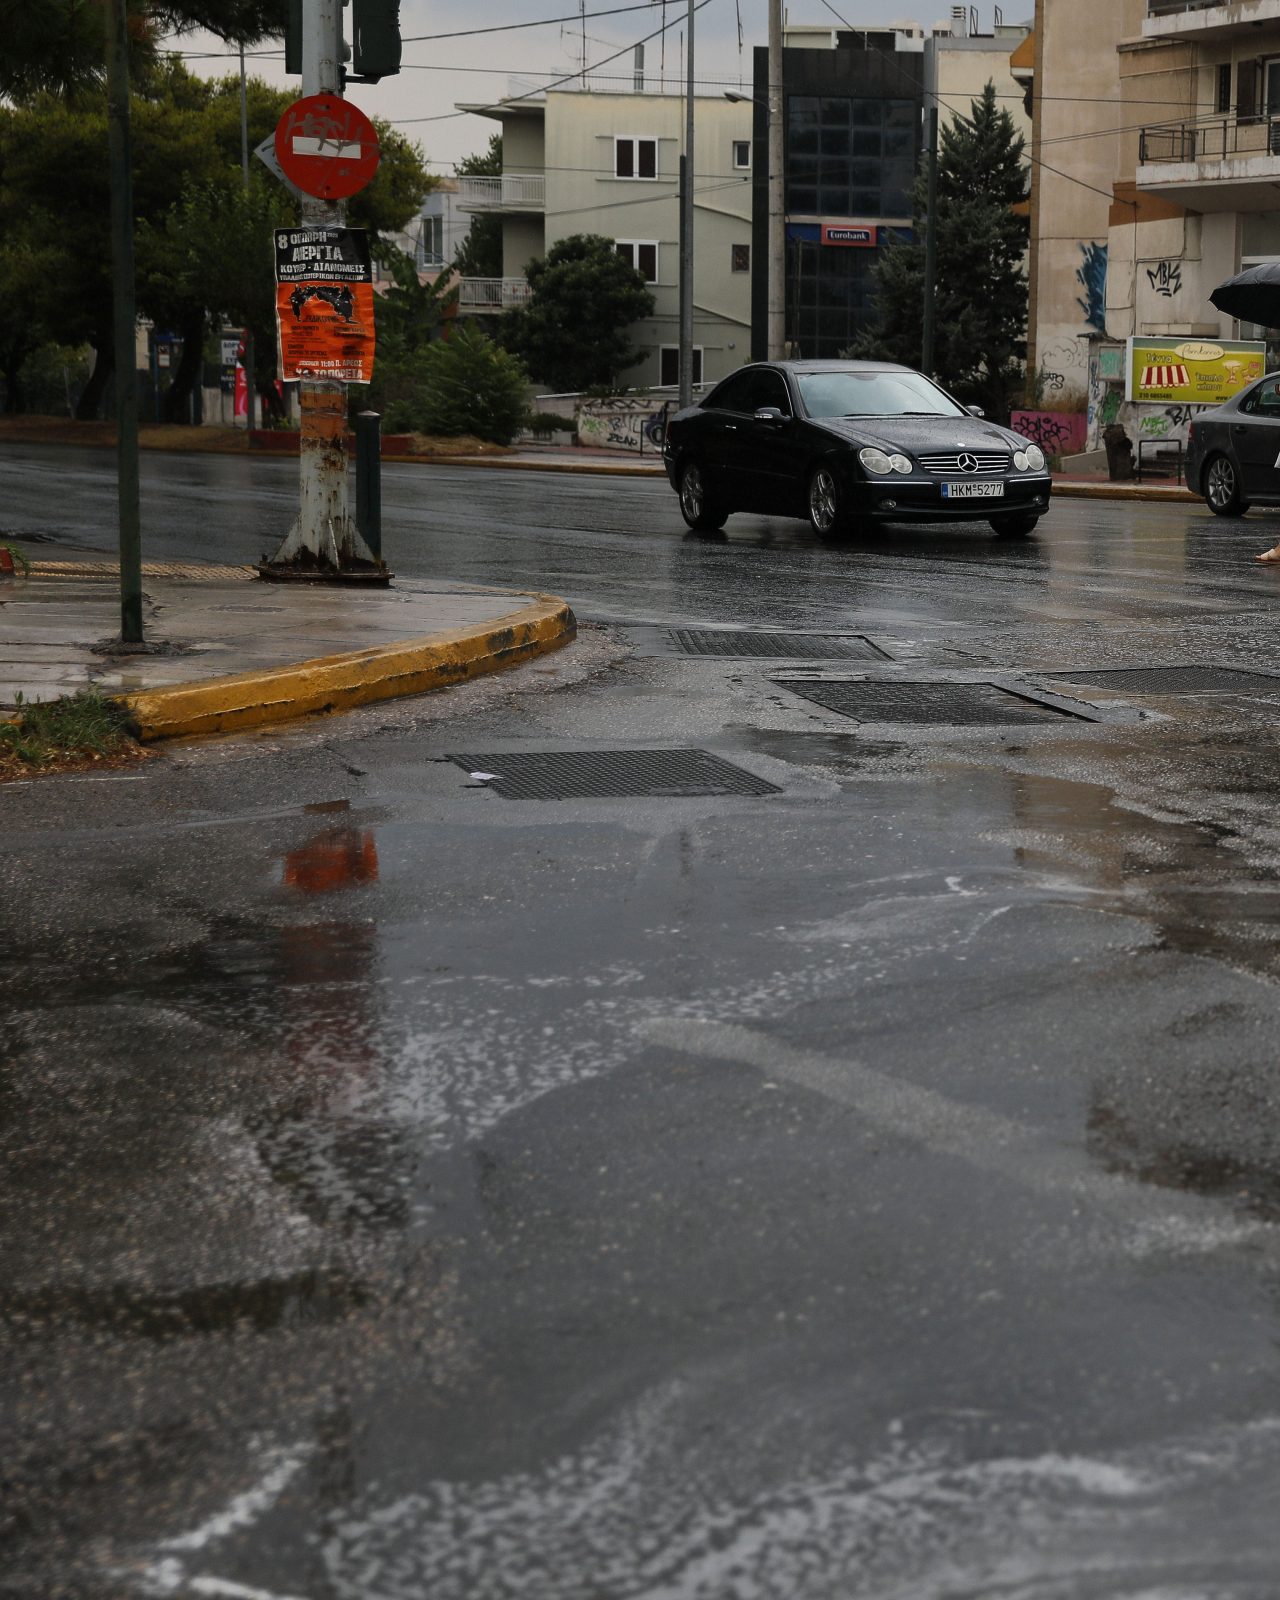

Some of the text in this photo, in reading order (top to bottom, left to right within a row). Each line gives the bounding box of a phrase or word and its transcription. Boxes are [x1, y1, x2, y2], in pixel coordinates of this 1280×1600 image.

[278, 234, 288, 249] 8
[830, 231, 866, 240] Eurobank
[313, 262, 365, 274] ΔΙΑΝΟΜΕΙΣ
